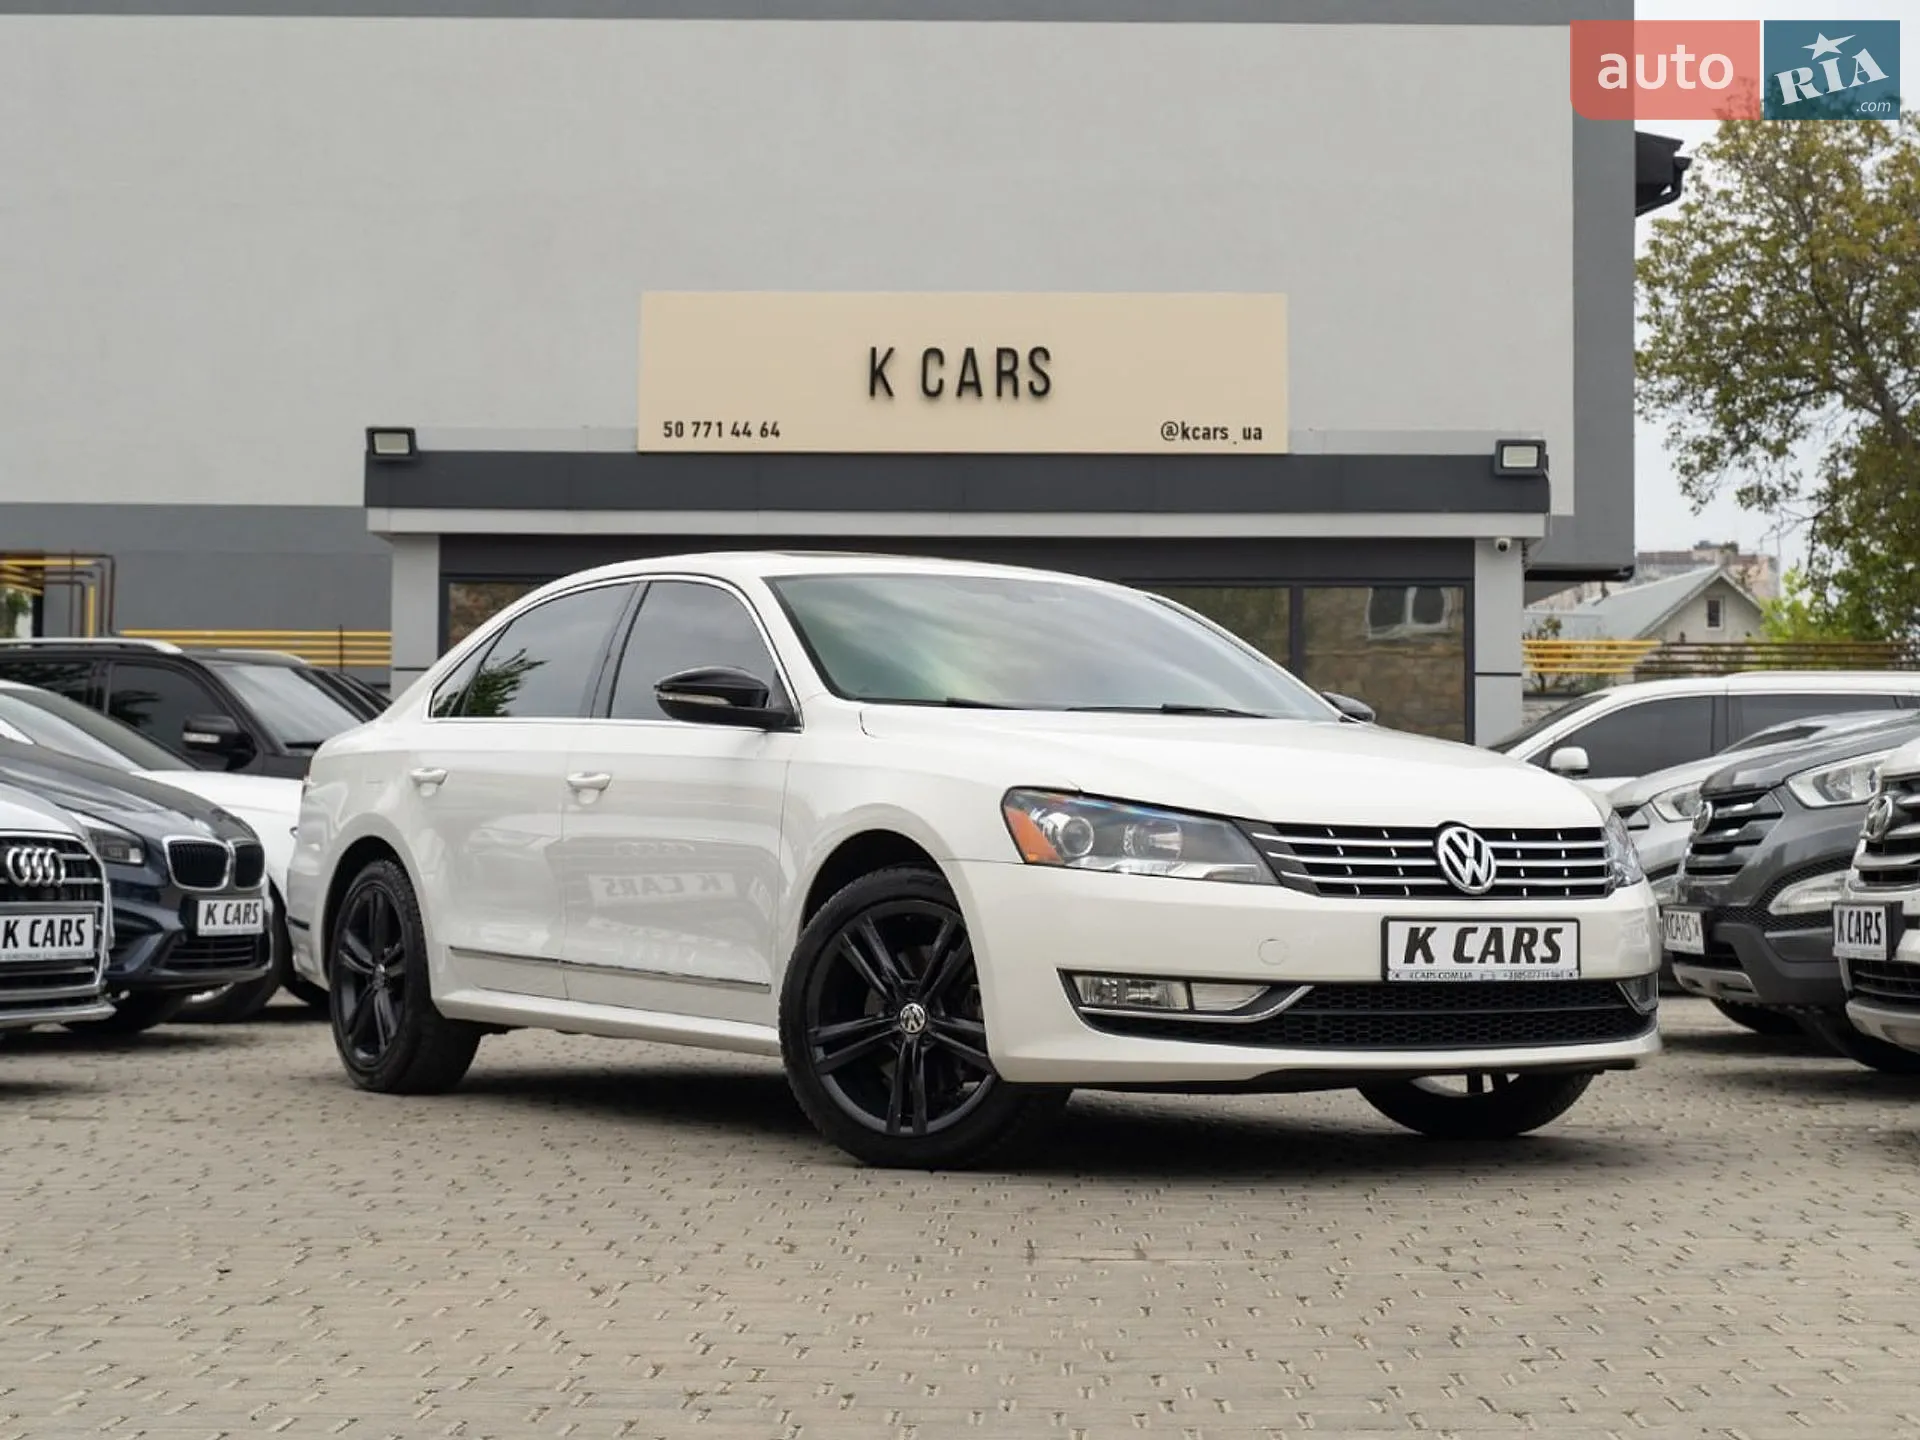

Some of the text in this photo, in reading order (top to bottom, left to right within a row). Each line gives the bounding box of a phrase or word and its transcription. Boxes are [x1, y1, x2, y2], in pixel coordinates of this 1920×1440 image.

[869, 346, 1051, 398] K CARS
[663, 420, 780, 438] 50 771 44 64
[204, 902, 259, 926] K CARS
[1848, 910, 1882, 945] CARS
[2, 918, 86, 949] K CARS
[1403, 926, 1563, 964] K CARS
